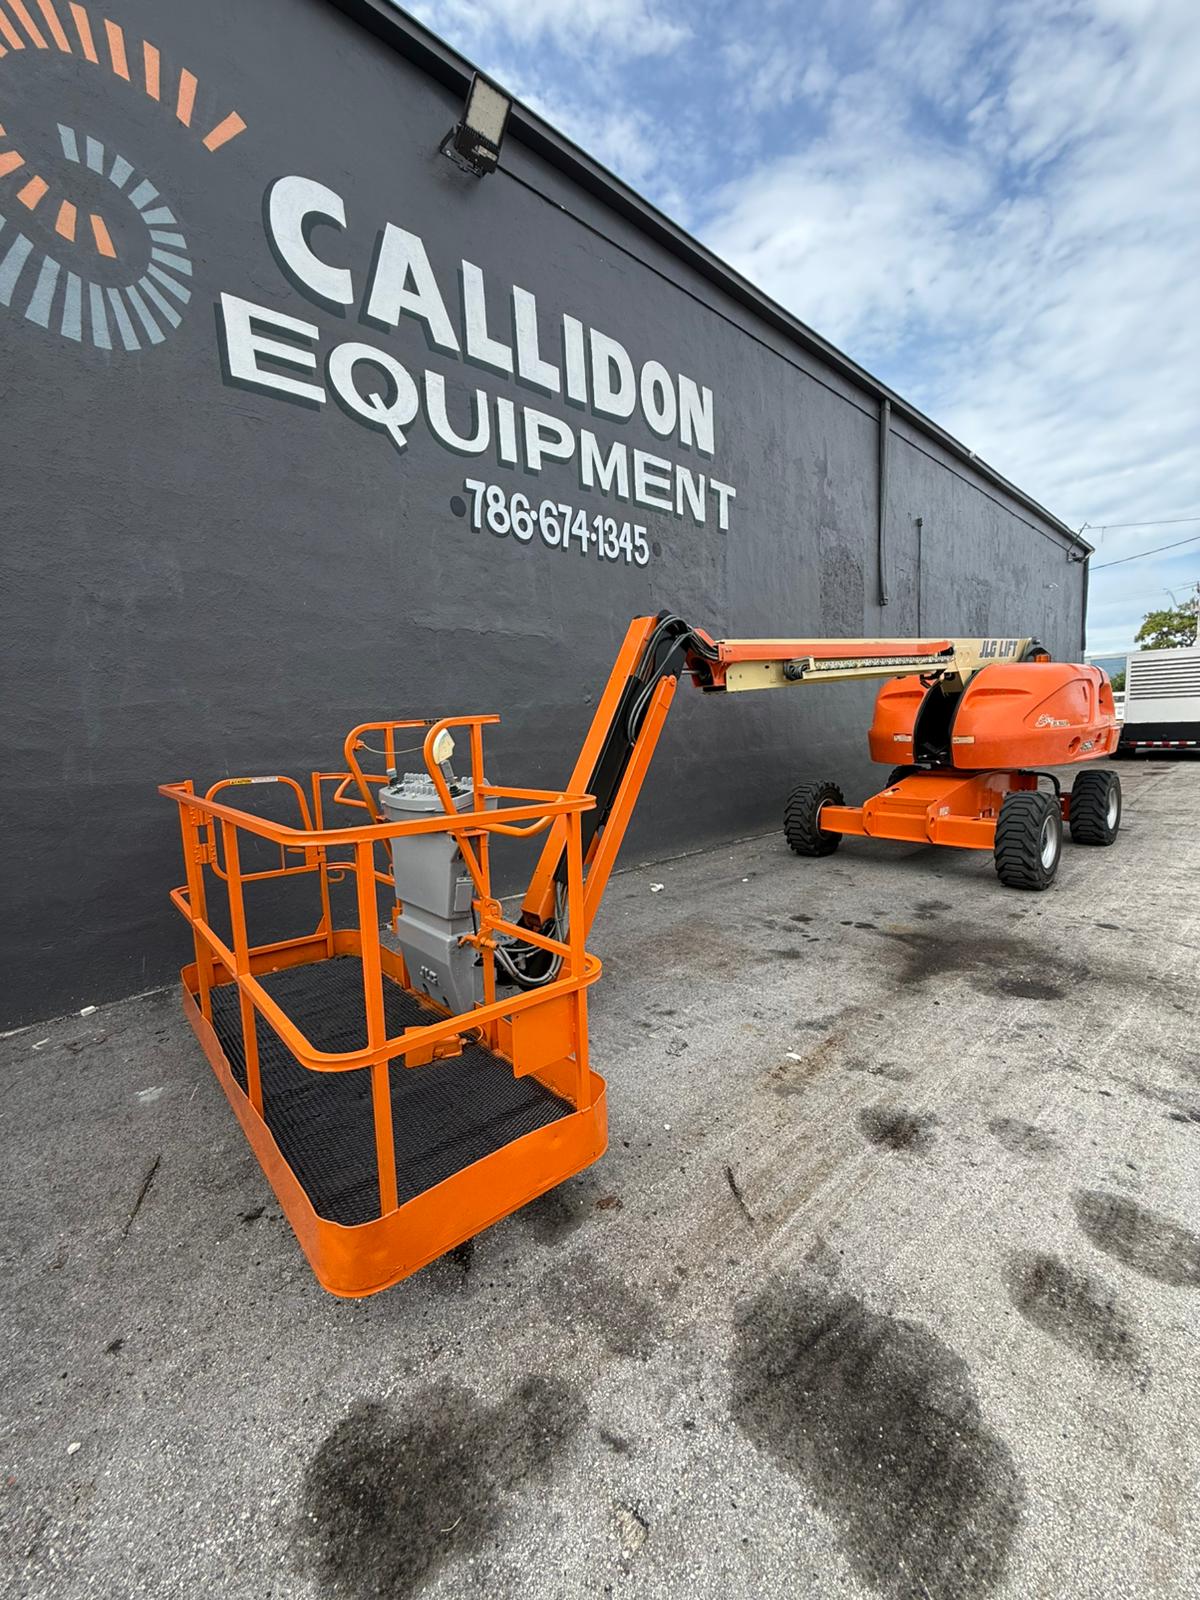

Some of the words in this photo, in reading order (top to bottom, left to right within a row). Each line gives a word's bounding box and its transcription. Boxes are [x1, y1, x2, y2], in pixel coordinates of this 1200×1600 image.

[219, 291, 738, 532] EQUIPMENT
[268, 175, 716, 456] CALLIDON
[979, 640, 997, 658] JLG
[998, 640, 1018, 657] LIFT
